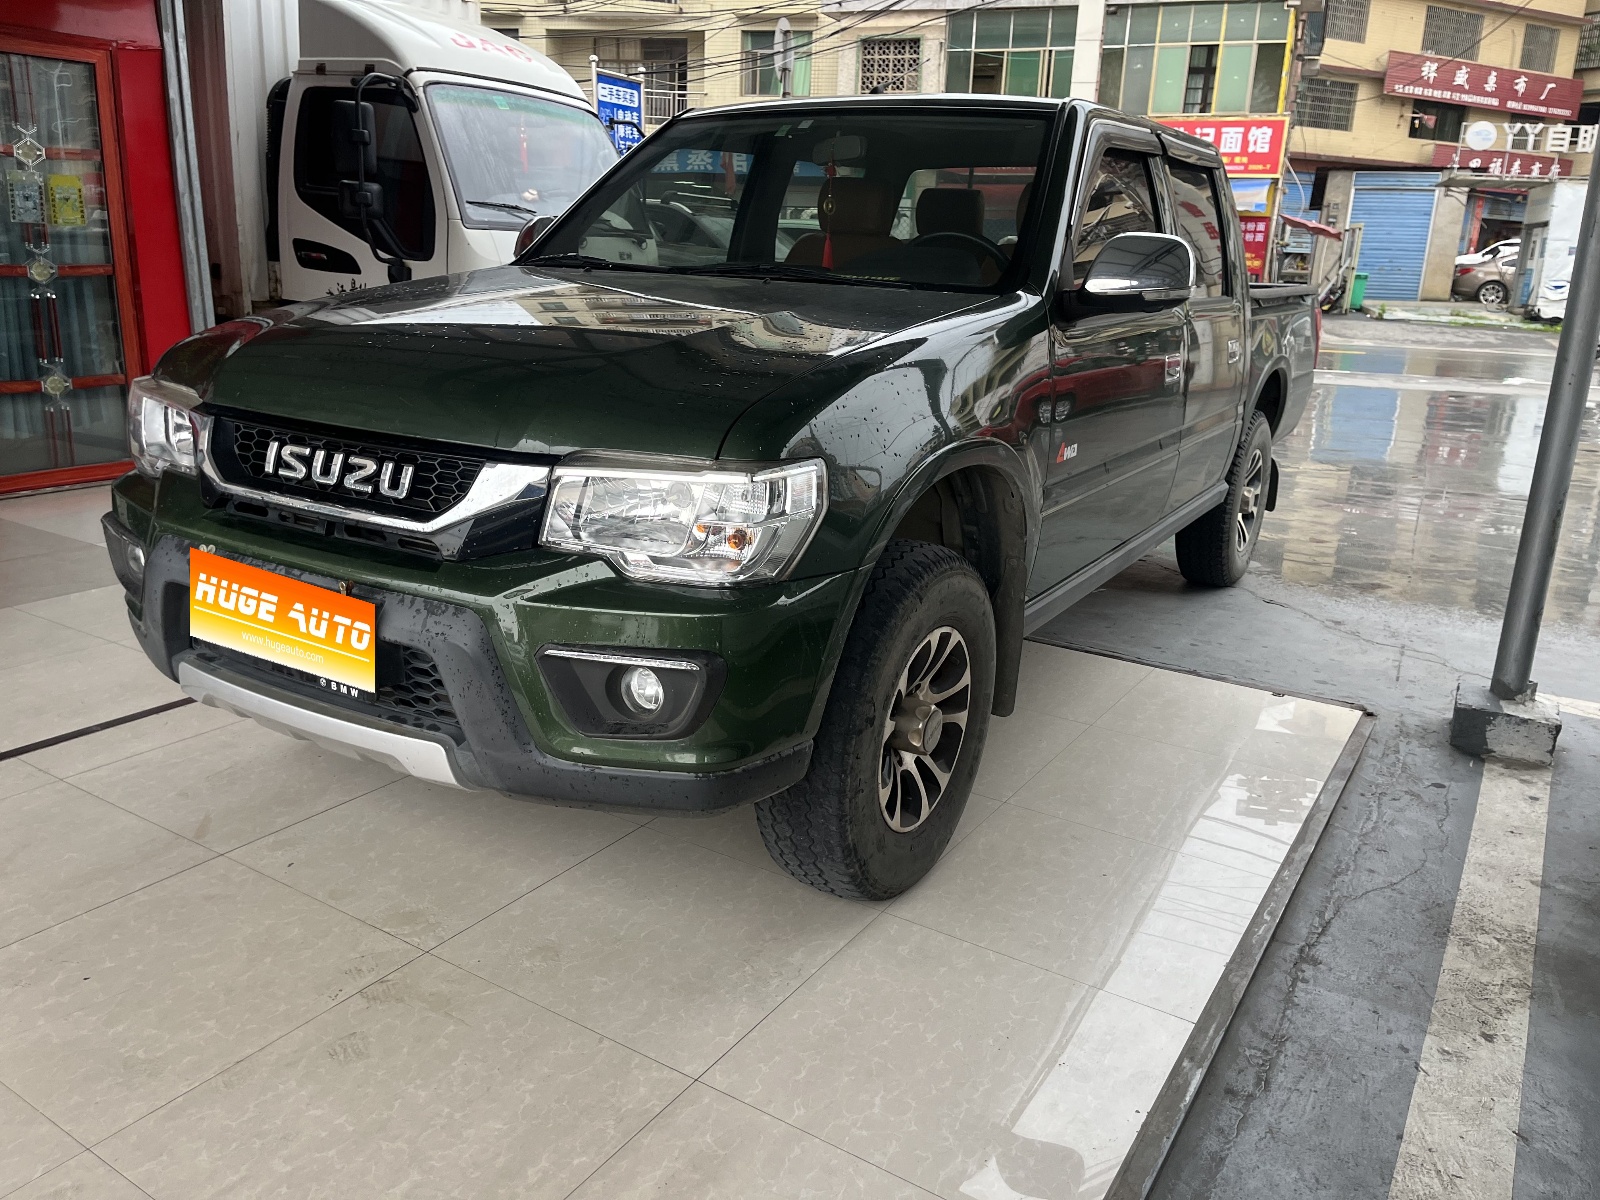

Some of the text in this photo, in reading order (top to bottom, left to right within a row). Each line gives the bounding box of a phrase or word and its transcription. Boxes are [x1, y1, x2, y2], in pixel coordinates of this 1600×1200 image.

[450, 32, 532, 63] JAC
[264, 441, 415, 500] ISUZU
[331, 681, 358, 698] BMW
